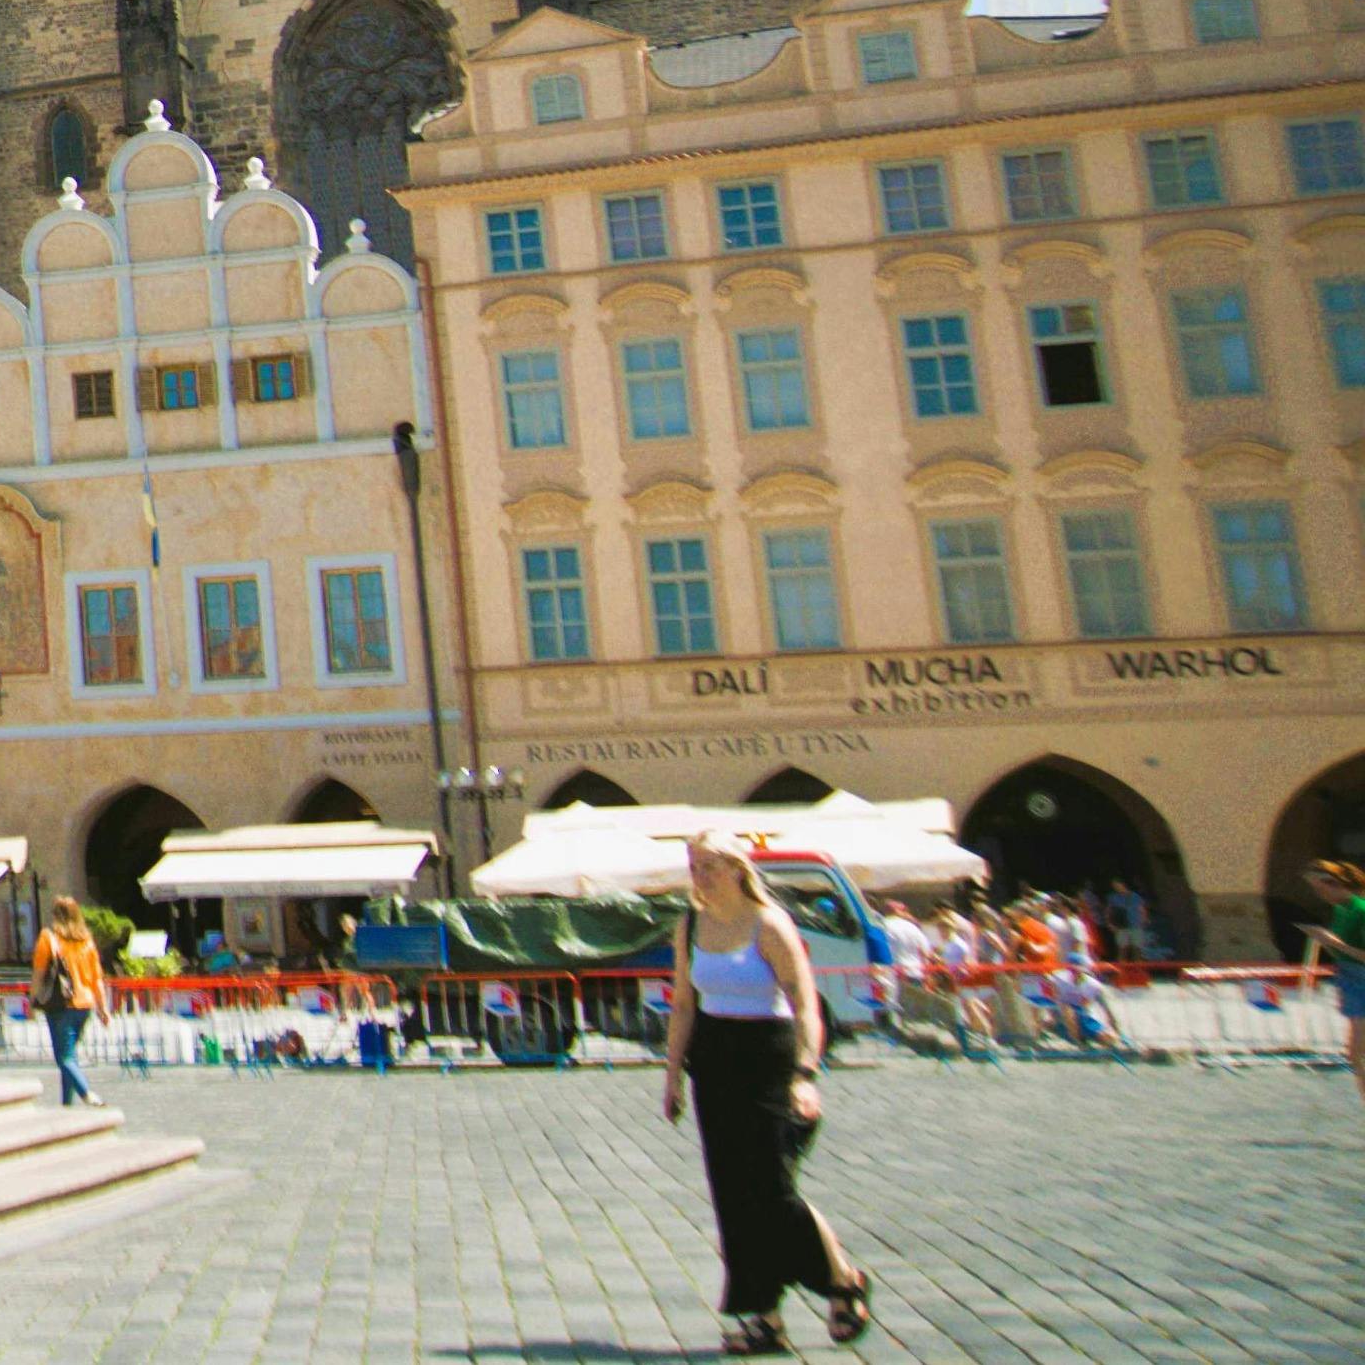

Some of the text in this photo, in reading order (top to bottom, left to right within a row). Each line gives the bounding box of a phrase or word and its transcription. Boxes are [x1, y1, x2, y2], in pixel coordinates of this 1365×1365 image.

[693, 647, 1283, 696] DALÍ MUCHA WARHOL
[849, 688, 1032, 715] exhibition
[525, 736, 692, 763] RESTAURANT
